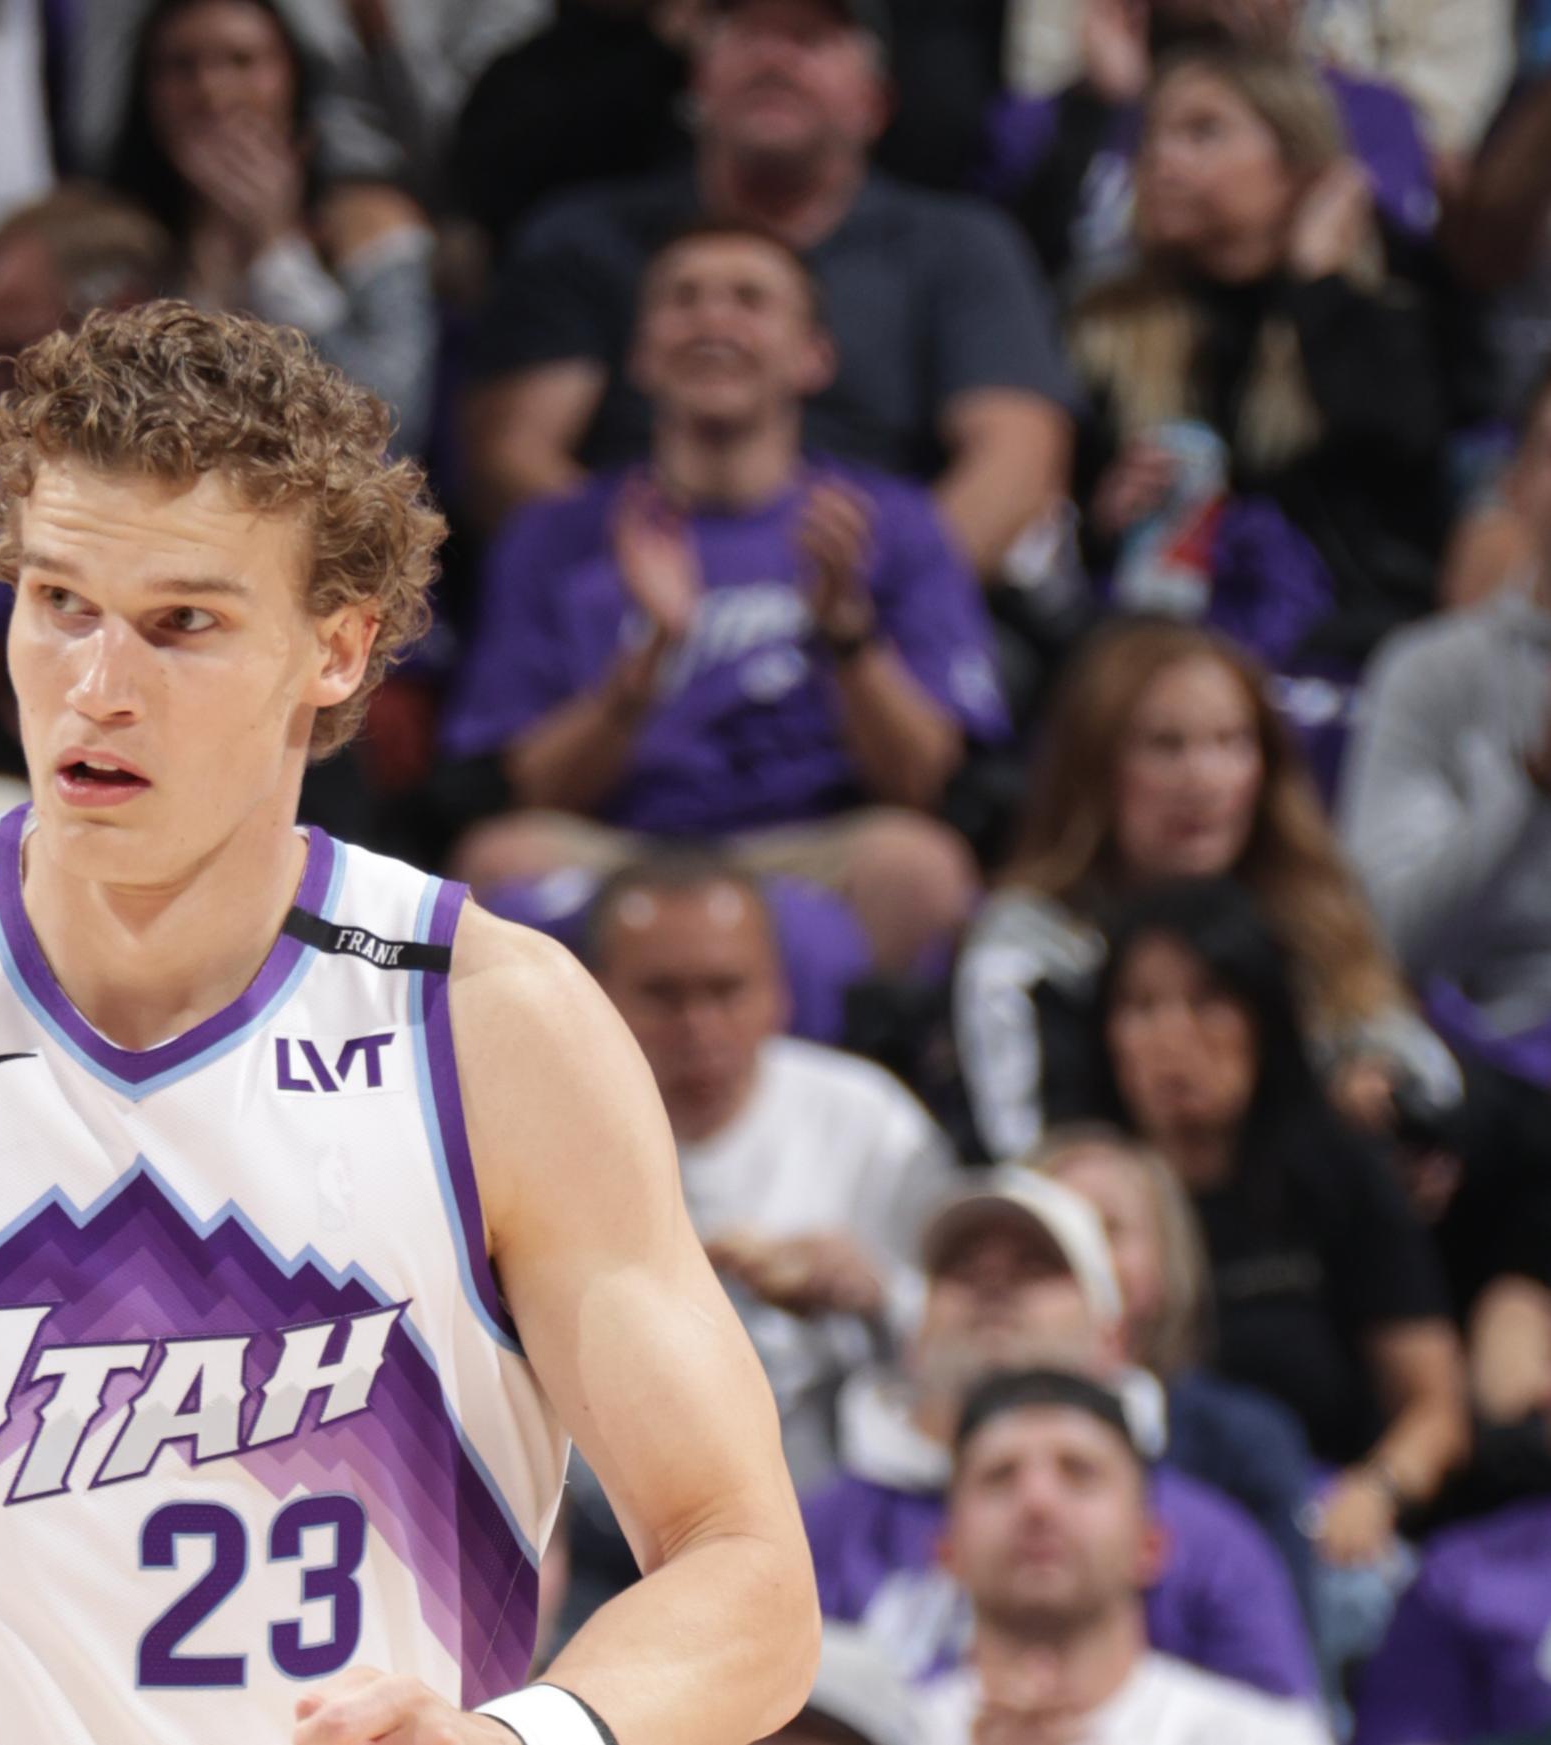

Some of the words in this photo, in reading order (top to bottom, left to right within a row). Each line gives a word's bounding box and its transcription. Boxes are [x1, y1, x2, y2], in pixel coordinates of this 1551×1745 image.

[335, 929, 404, 965] FRANK
[275, 1032, 395, 1092] LVT
[136, 1491, 367, 1688] 23
